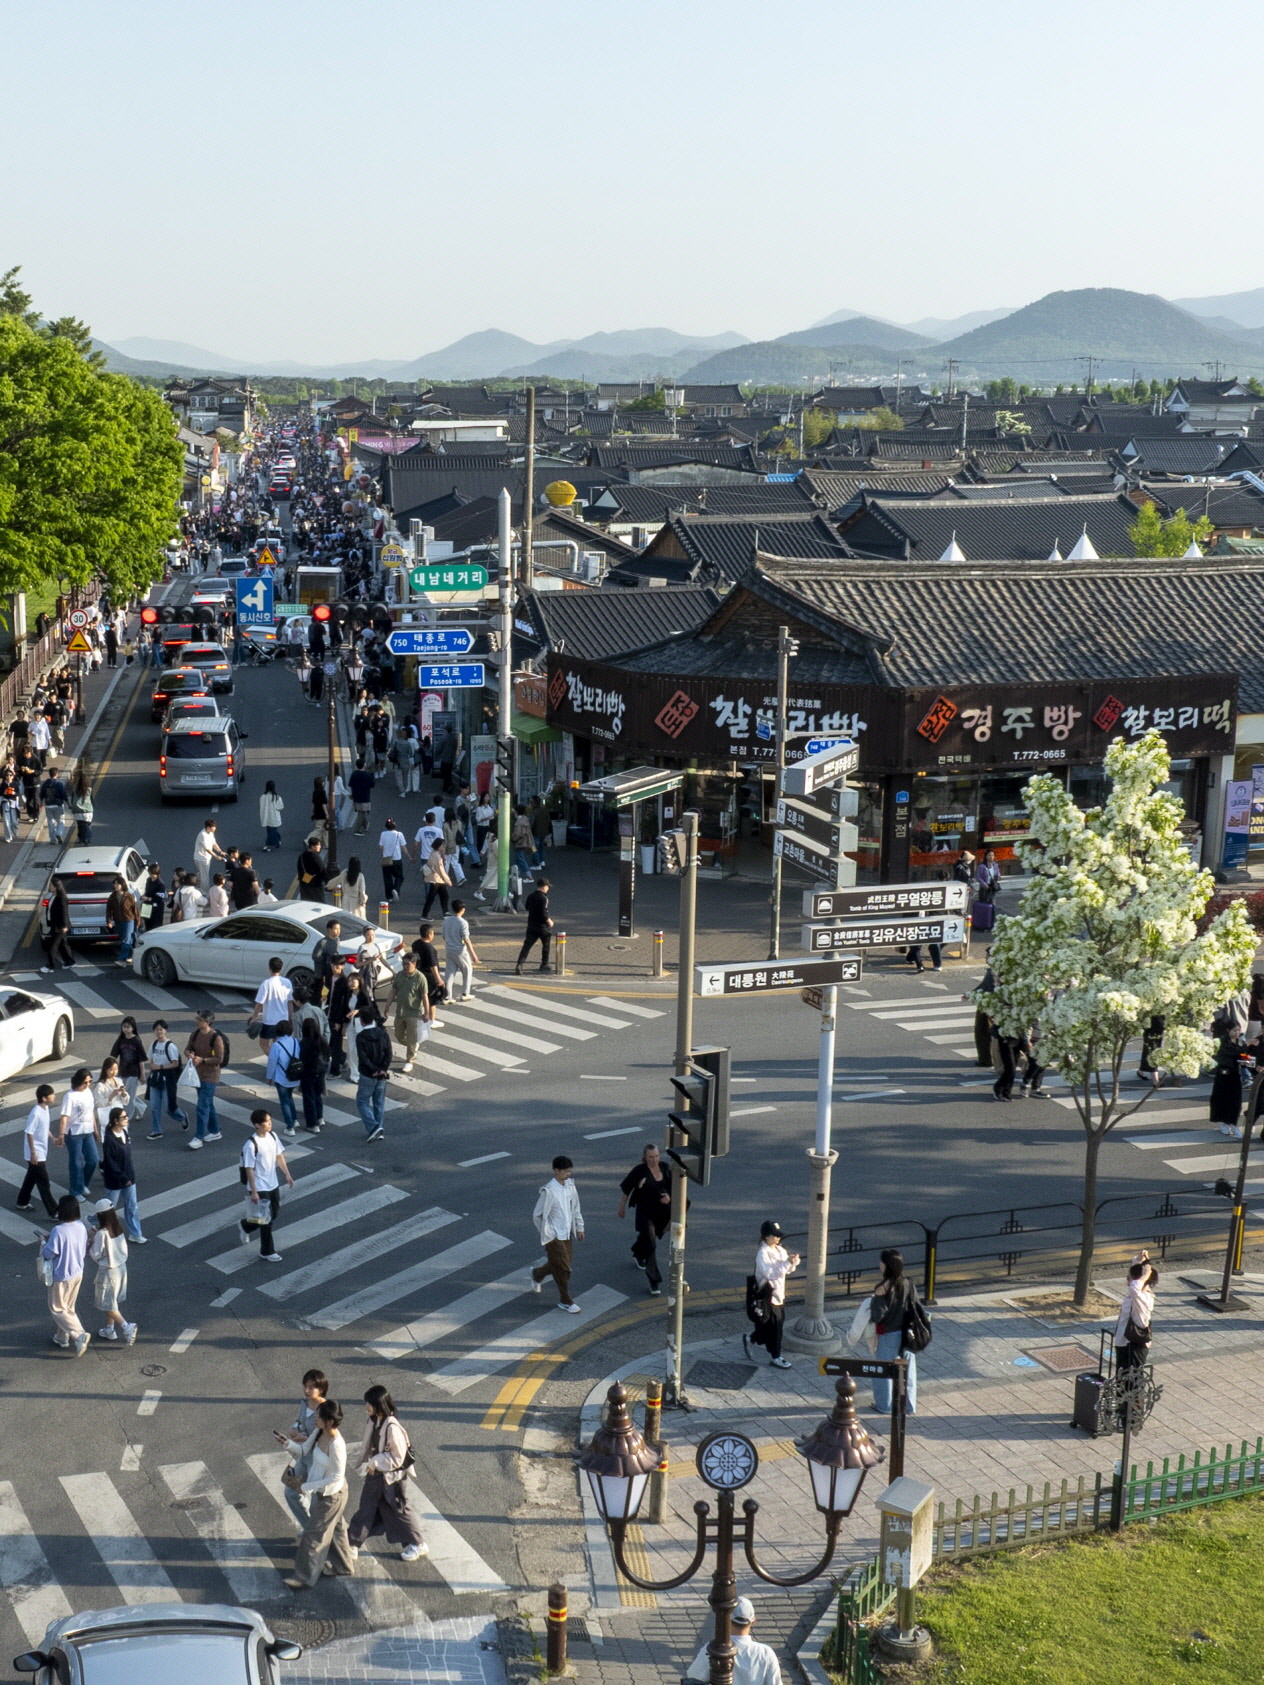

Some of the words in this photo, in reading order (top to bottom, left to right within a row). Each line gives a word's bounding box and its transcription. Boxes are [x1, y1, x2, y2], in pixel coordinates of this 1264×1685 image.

[414, 571, 482, 586] 내남네거리
[73, 615, 84, 623] 30
[239, 612, 271, 623] 동시신호
[393, 639, 407, 647] 750
[413, 633, 446, 644] 태종로
[453, 637, 467, 645] 746
[430, 667, 461, 677] 포석로
[565, 670, 626, 735] 찰보리빵
[960, 705, 1082, 743] 경주빵
[1122, 699, 1232, 737] 찰보리떡
[729, 745, 747, 756] 본점
[1013, 749, 1066, 761] T.772-0665
[895, 806, 909, 838] 본점
[896, 890, 944, 908] 무열왕릉
[872, 926, 941, 943] 김유신장군묘
[729, 971, 767, 988] 대릉원
[861, 1365, 884, 1374] 천마총
